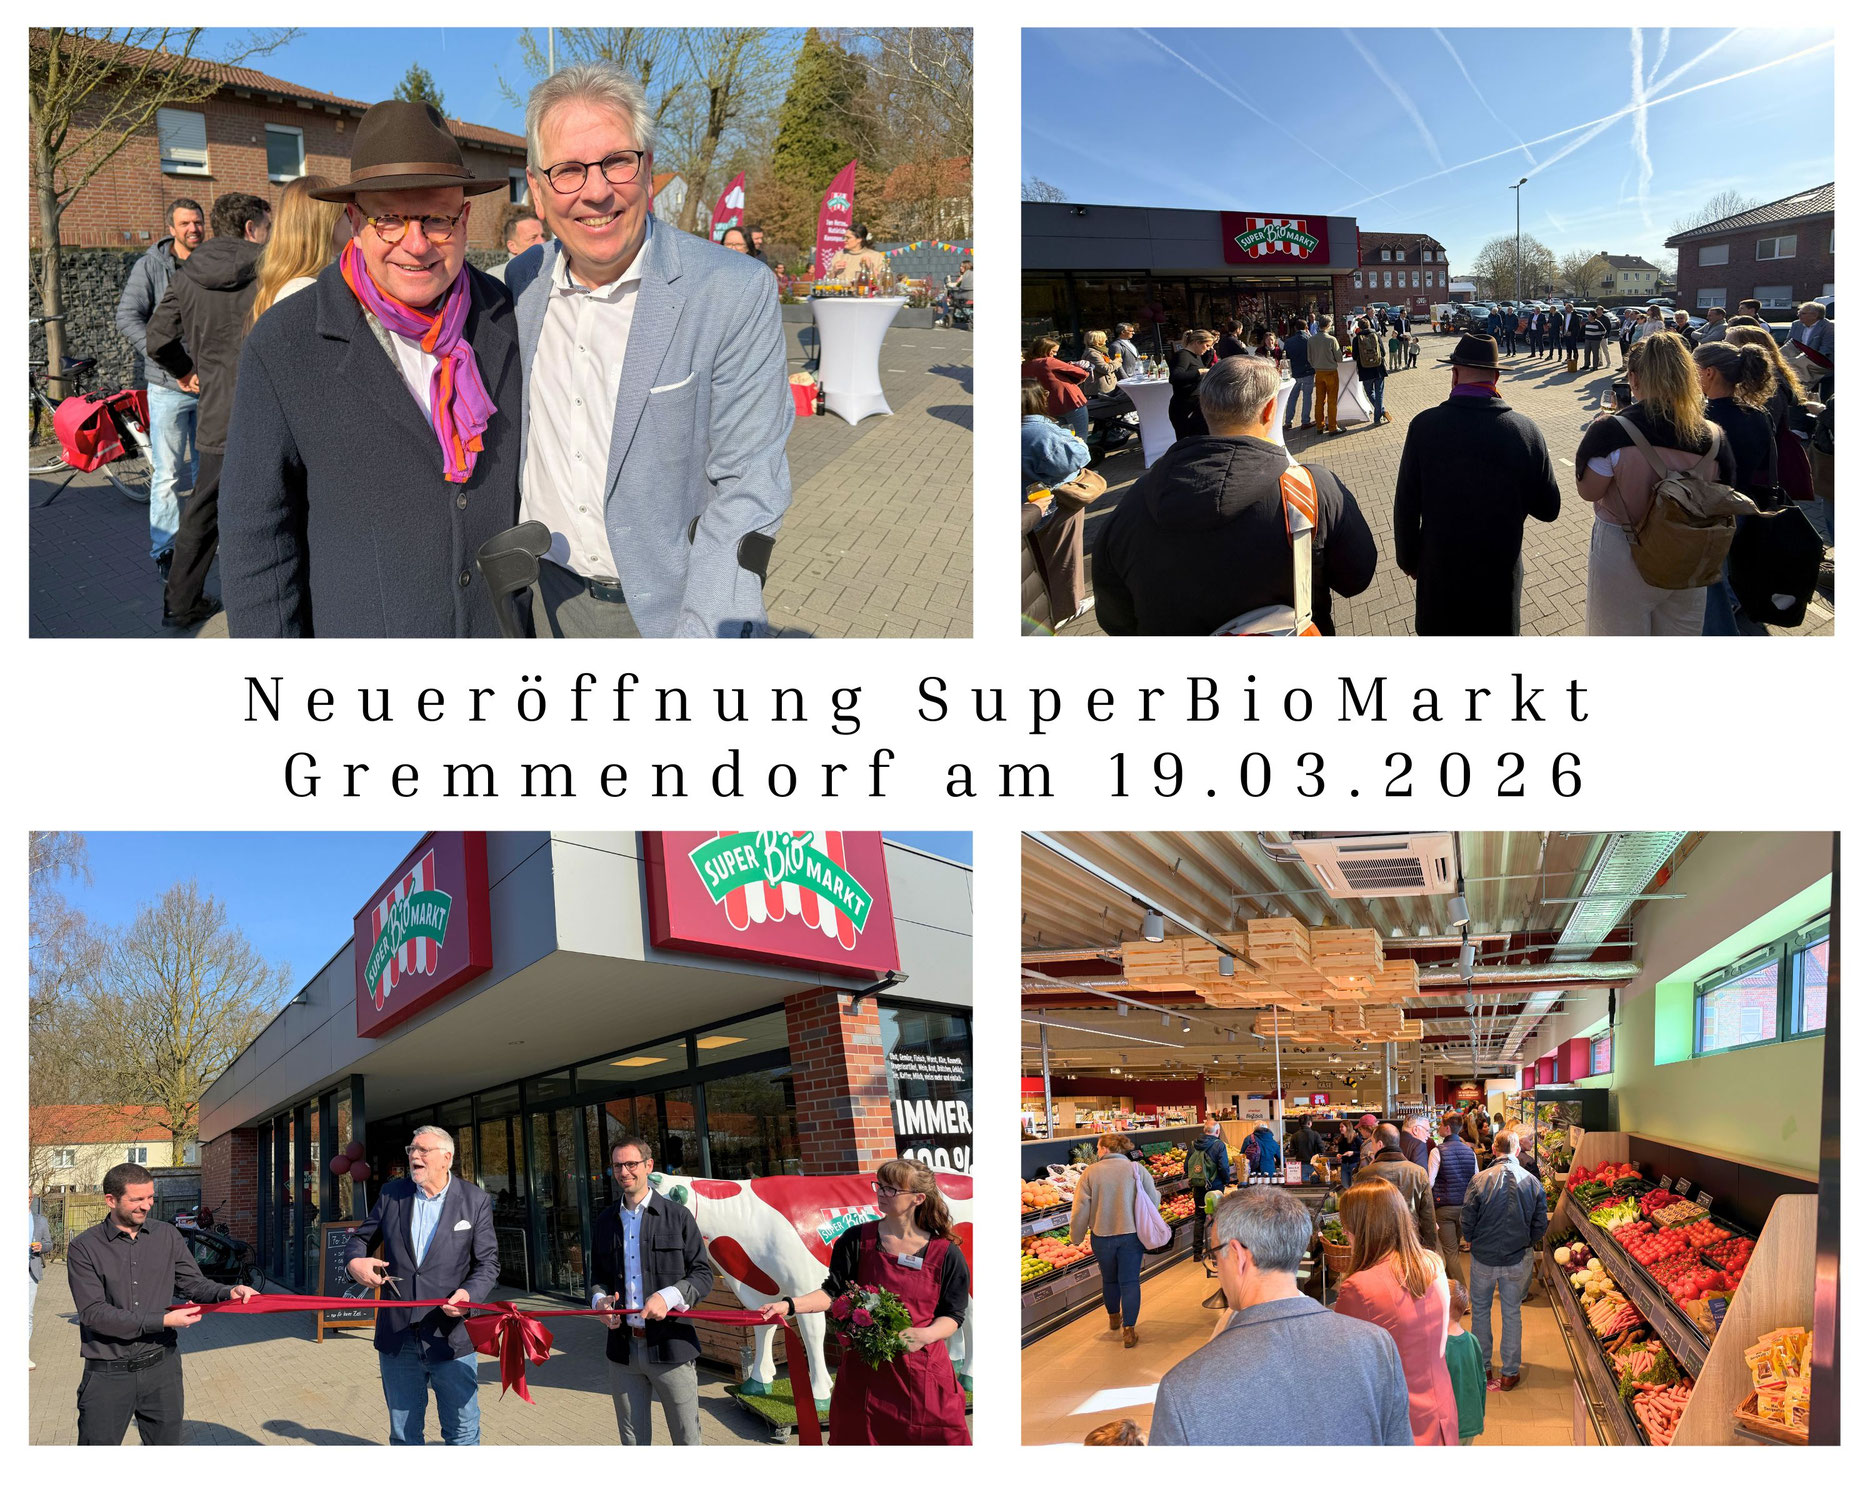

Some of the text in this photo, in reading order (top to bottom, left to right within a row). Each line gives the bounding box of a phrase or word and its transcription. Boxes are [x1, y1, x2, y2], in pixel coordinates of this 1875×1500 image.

[1241, 223, 1315, 248] SUPER Bio MARKT
[704, 831, 865, 917] SUPER Bio MARKT
[369, 880, 447, 986] SUPER Bio MARKT
[896, 1099, 973, 1135] IMMER
[821, 1221, 844, 1240] SUPER
